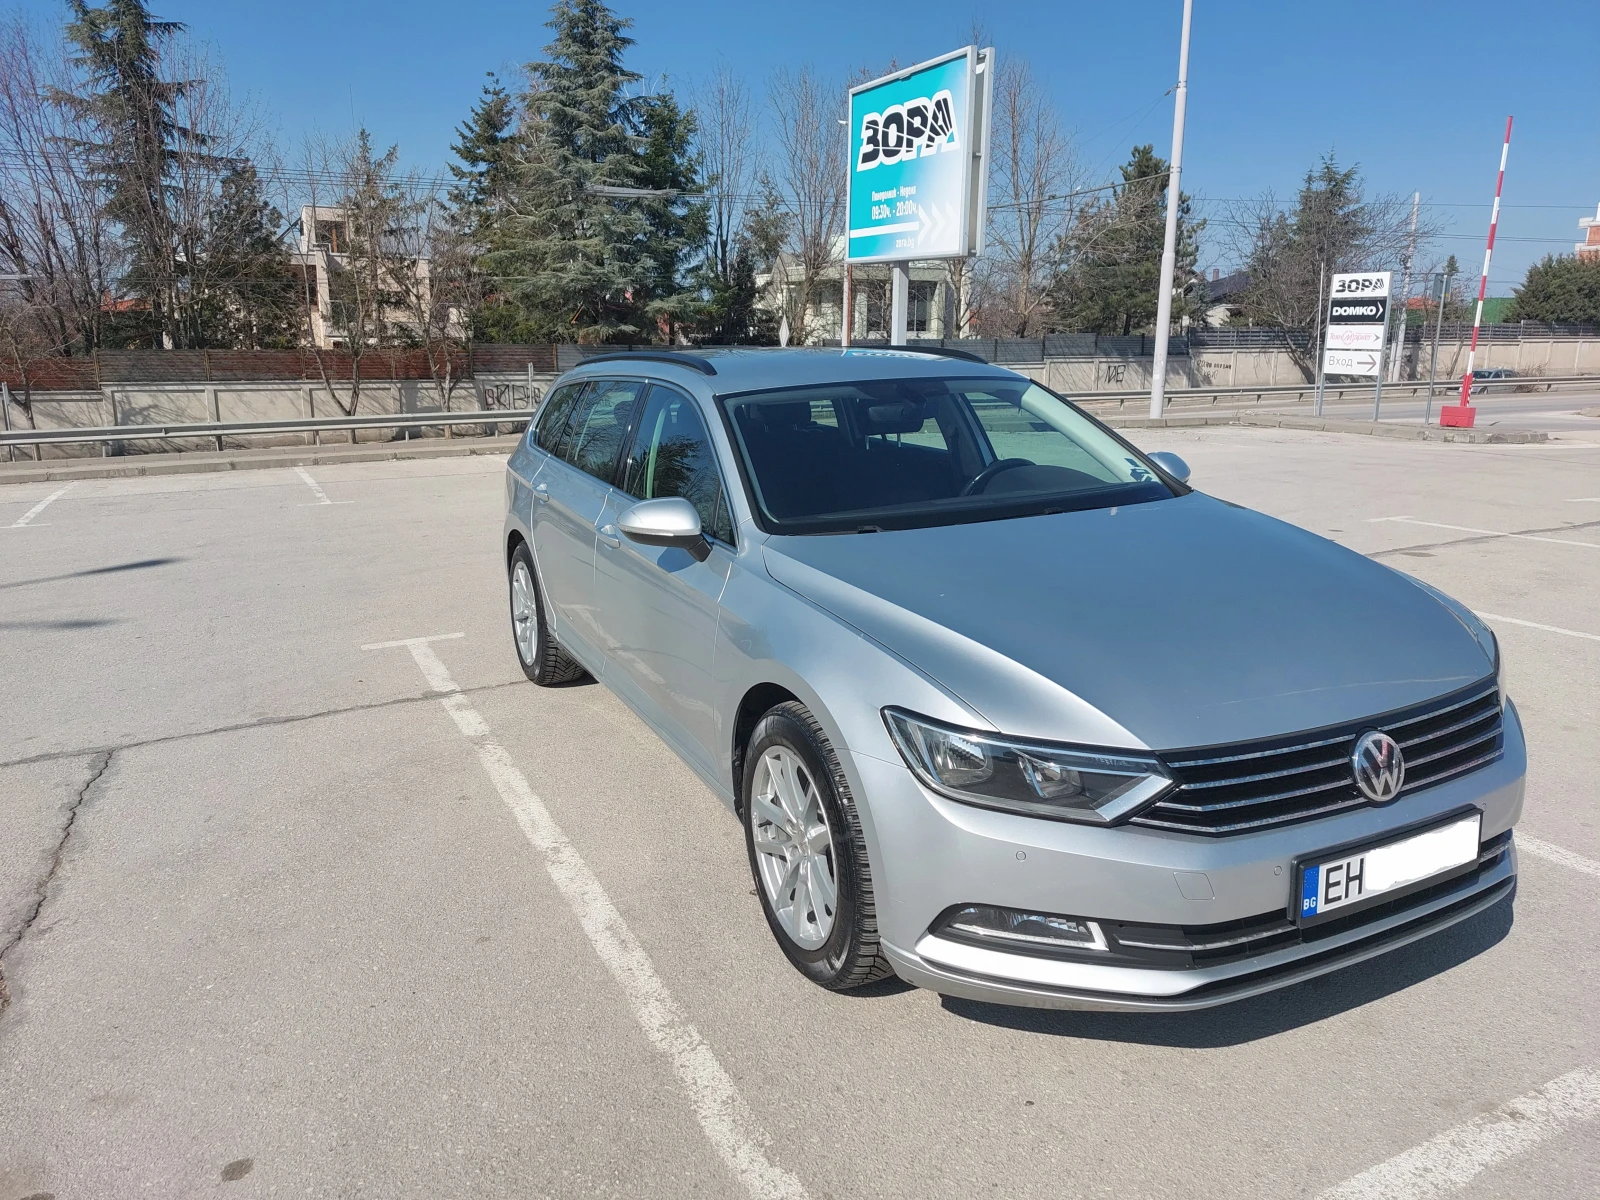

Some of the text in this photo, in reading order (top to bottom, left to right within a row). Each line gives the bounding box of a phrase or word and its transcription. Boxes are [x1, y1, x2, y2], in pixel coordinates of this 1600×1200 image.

[859, 96, 954, 166] ЗОРА
[895, 236, 915, 249] zora.bg
[1335, 277, 1385, 293] ЗОРА
[1332, 306, 1377, 316] DOMKO
[1328, 355, 1353, 368] Вход
[1323, 857, 1365, 906] EH
[1303, 896, 1317, 910] BG
